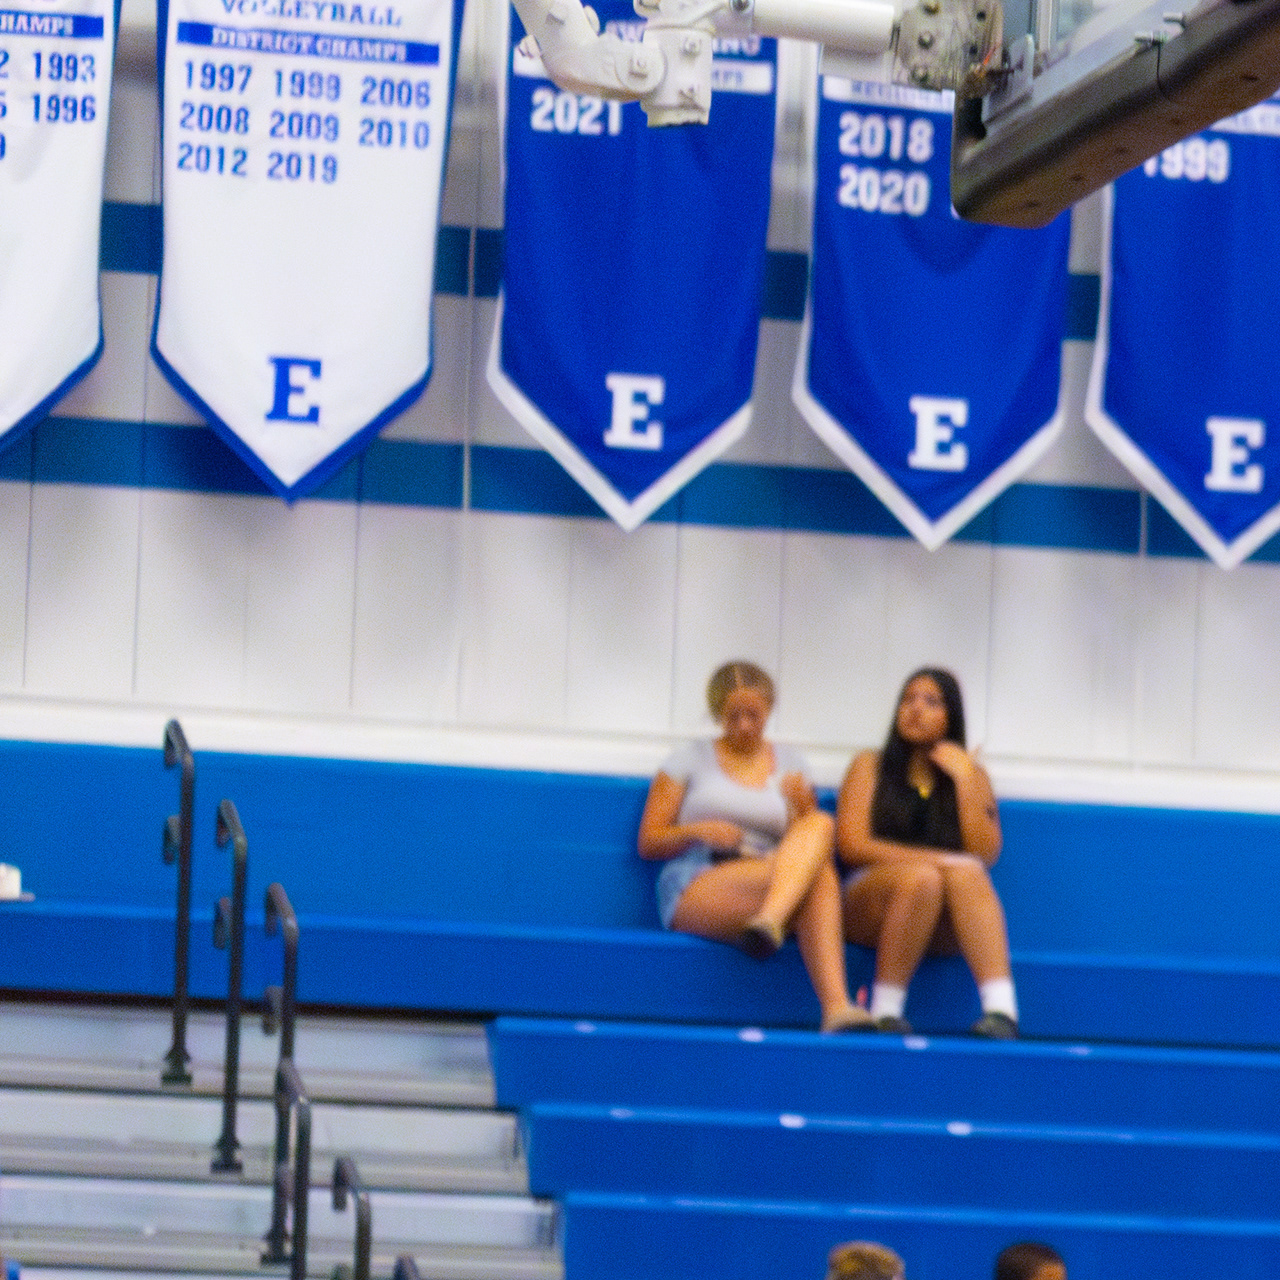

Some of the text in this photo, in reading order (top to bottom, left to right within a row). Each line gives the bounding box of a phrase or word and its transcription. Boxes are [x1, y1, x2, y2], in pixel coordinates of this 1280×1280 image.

[33, 51, 96, 85] 1993
[185, 61, 252, 94] 1997
[275, 69, 341, 101] 1999
[33, 92, 96, 123] 1996
[180, 101, 430, 149] 2008 2009 2010
[531, 88, 622, 136] 2021
[838, 110, 934, 163] 2018
[177, 142, 337, 184] 2012 2019
[838, 162, 931, 217] 2020
[266, 355, 322, 426] E
[604, 374, 665, 451] E
[909, 396, 968, 472] E
[1205, 417, 1265, 493] E
